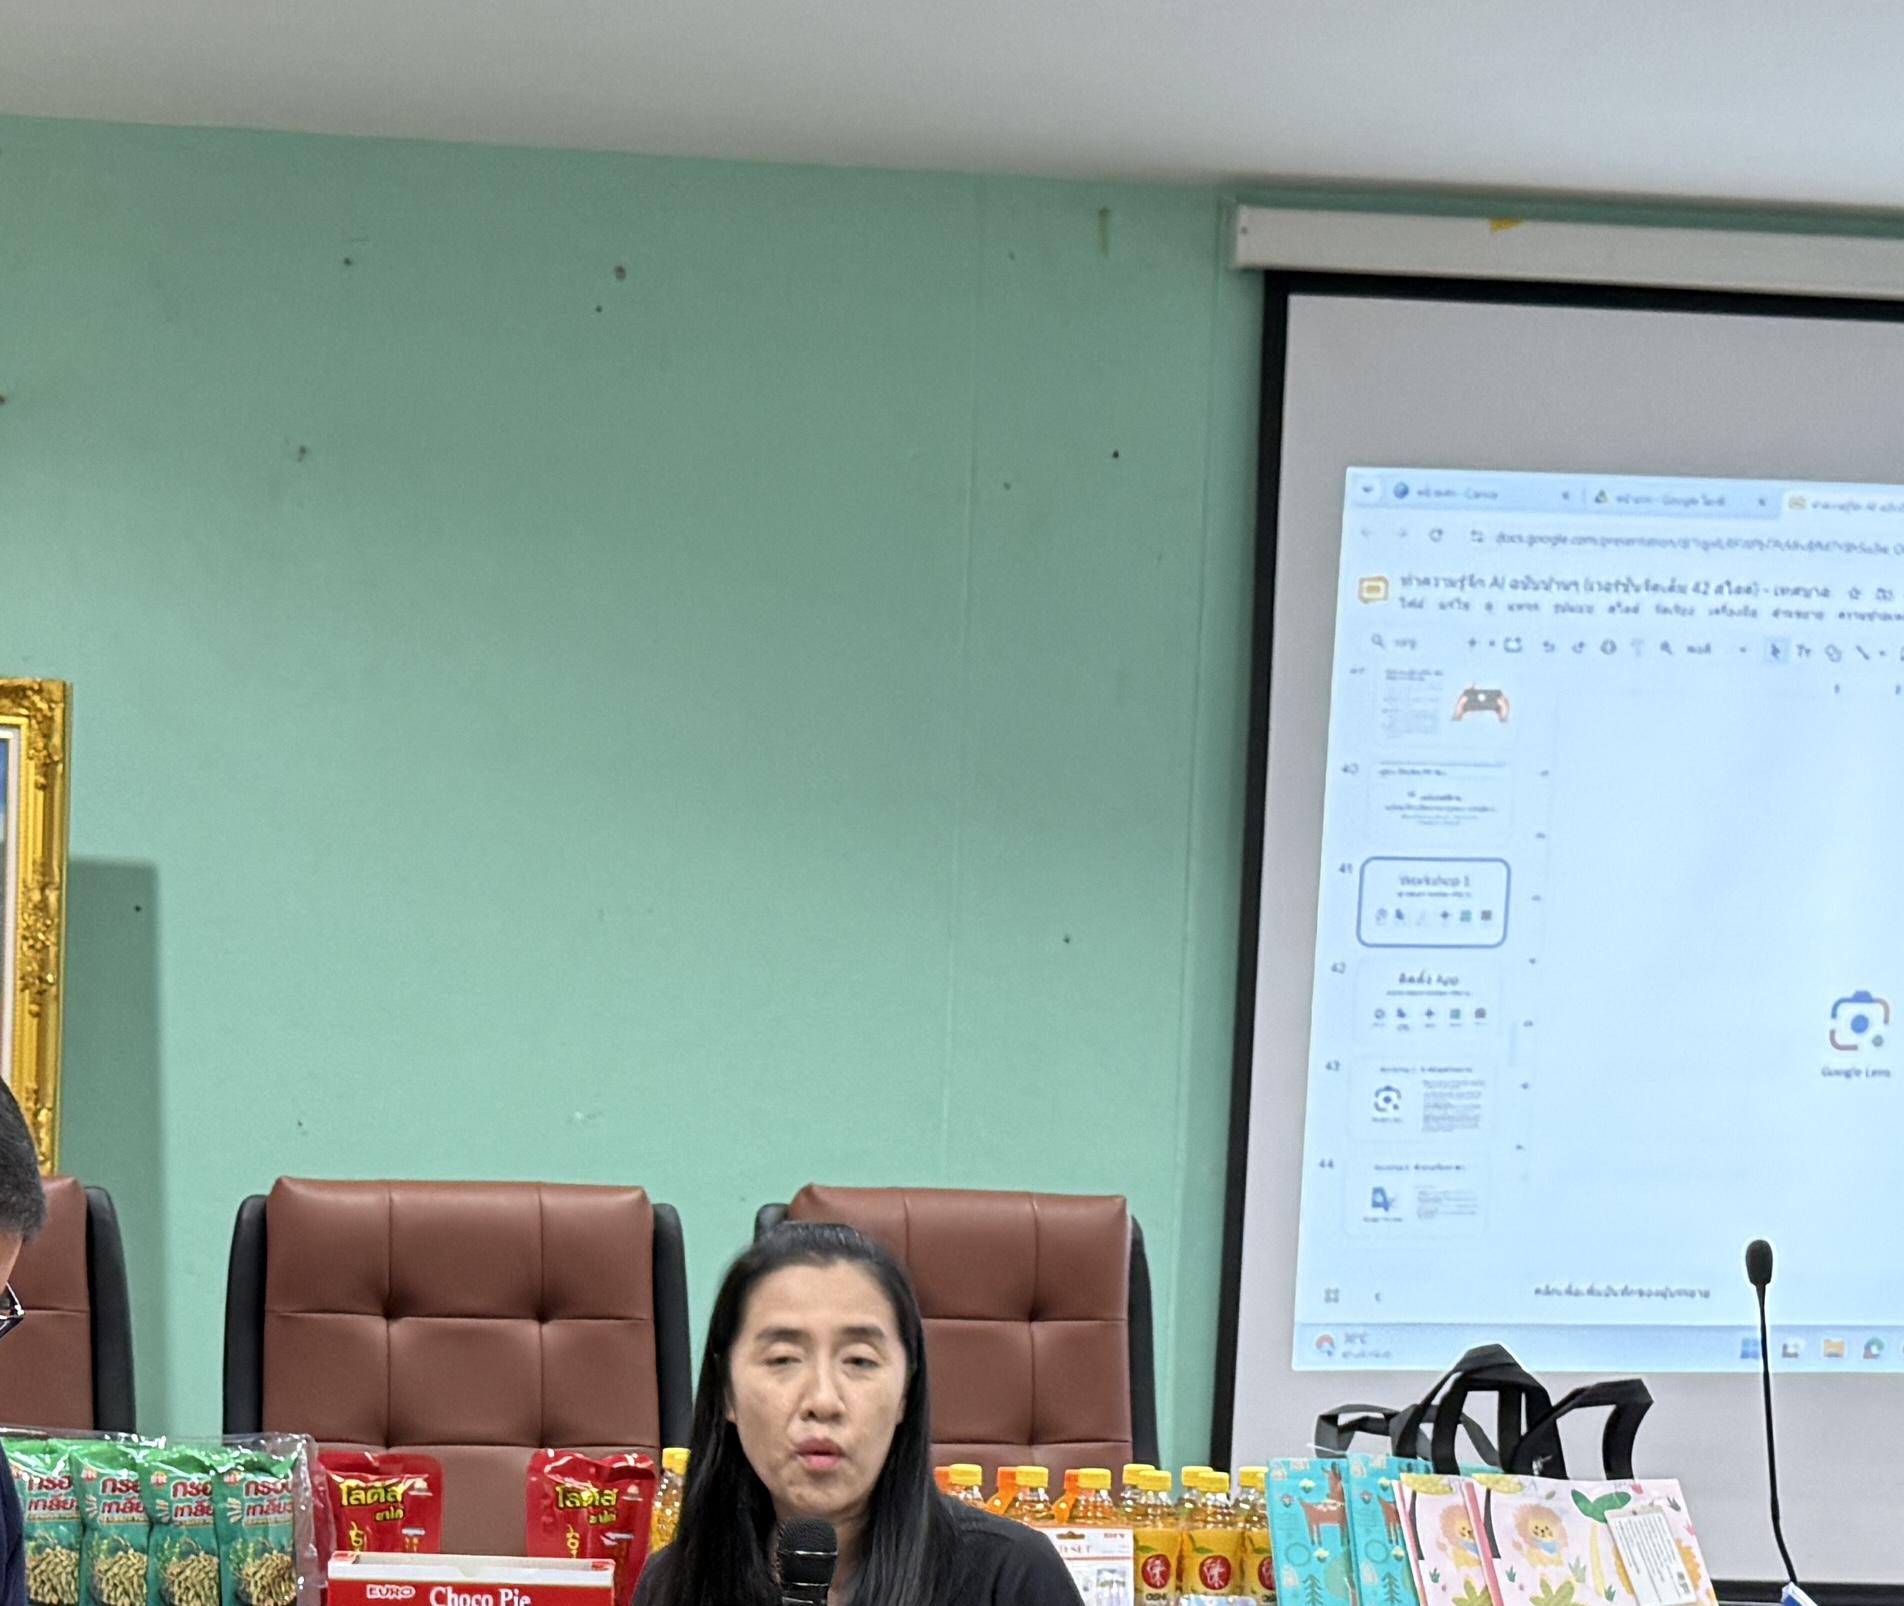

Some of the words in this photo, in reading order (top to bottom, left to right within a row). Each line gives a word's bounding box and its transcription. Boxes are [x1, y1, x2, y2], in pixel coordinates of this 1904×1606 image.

[1489, 575, 1505, 589] AI
[1691, 580, 1710, 595] 42
[1821, 1065, 1862, 1081] Google
[1865, 1066, 1892, 1080] Lens
[339, 1478, 405, 1507] โลตัส
[554, 1485, 620, 1509] โลตัส
[366, 1583, 416, 1600] EURO
